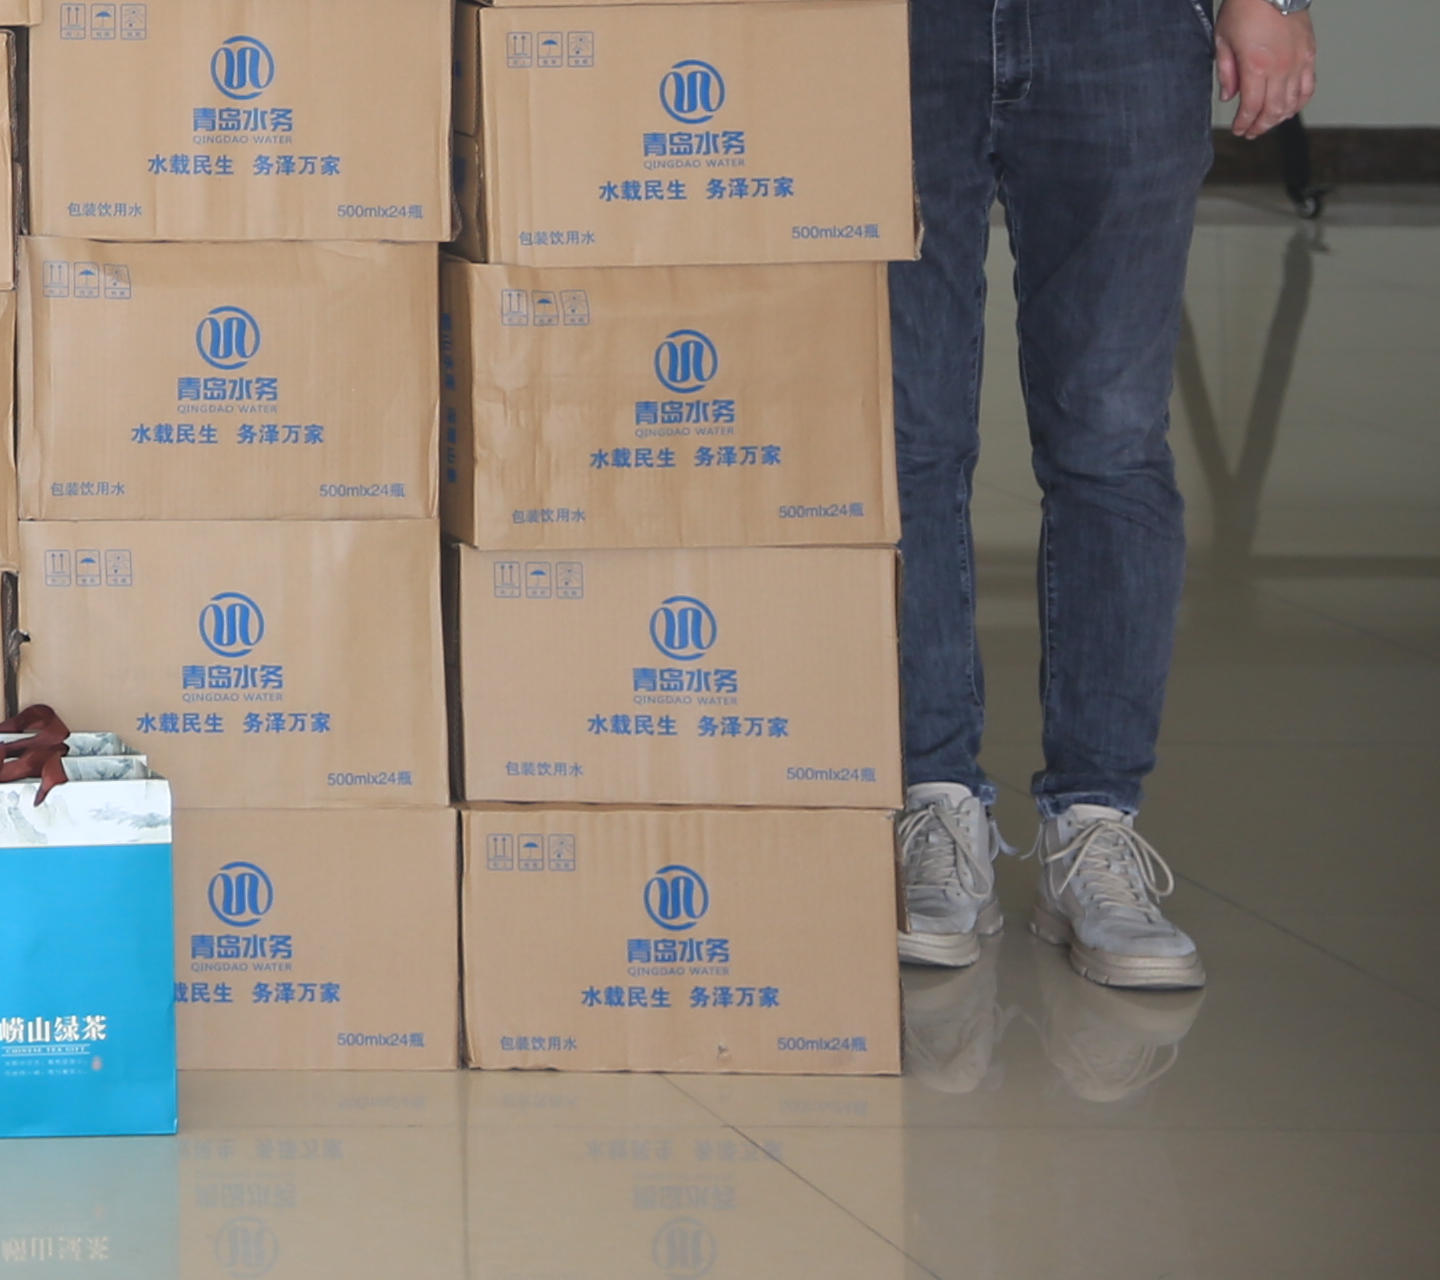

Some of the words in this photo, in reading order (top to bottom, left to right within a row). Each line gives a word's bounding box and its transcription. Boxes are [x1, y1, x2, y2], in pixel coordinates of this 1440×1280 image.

[193, 107, 294, 132] 青岛水务
[643, 131, 746, 156] 青岛水务
[149, 153, 234, 176] 水载民生
[253, 154, 342, 176] 务泽万家
[599, 179, 688, 202] 水载民生
[706, 176, 795, 200] 务泽万家
[178, 377, 279, 401] 青岛水务
[635, 399, 736, 425] 青岛水务
[131, 423, 218, 445] 水载民生
[238, 423, 325, 445] 务泽万家
[590, 447, 676, 469] 水载民生
[695, 444, 783, 467] 务泽万家
[183, 665, 284, 689] 青岛水务
[633, 667, 738, 692] 青岛水务
[137, 712, 224, 734] 水载民生
[243, 712, 332, 734] 务泽万家
[587, 713, 678, 736] 水载民生
[697, 715, 790, 738] 务泽万家
[505, 761, 584, 777] 包装饮用水
[191, 935, 293, 959] 青岛水务
[627, 938, 730, 963] 青岛水务
[252, 982, 341, 1003] 务泽万家
[582, 985, 671, 1008] 水载民生
[690, 985, 781, 1008] 务泽万家
[0, 1015, 107, 1043] 崂山绿茶
